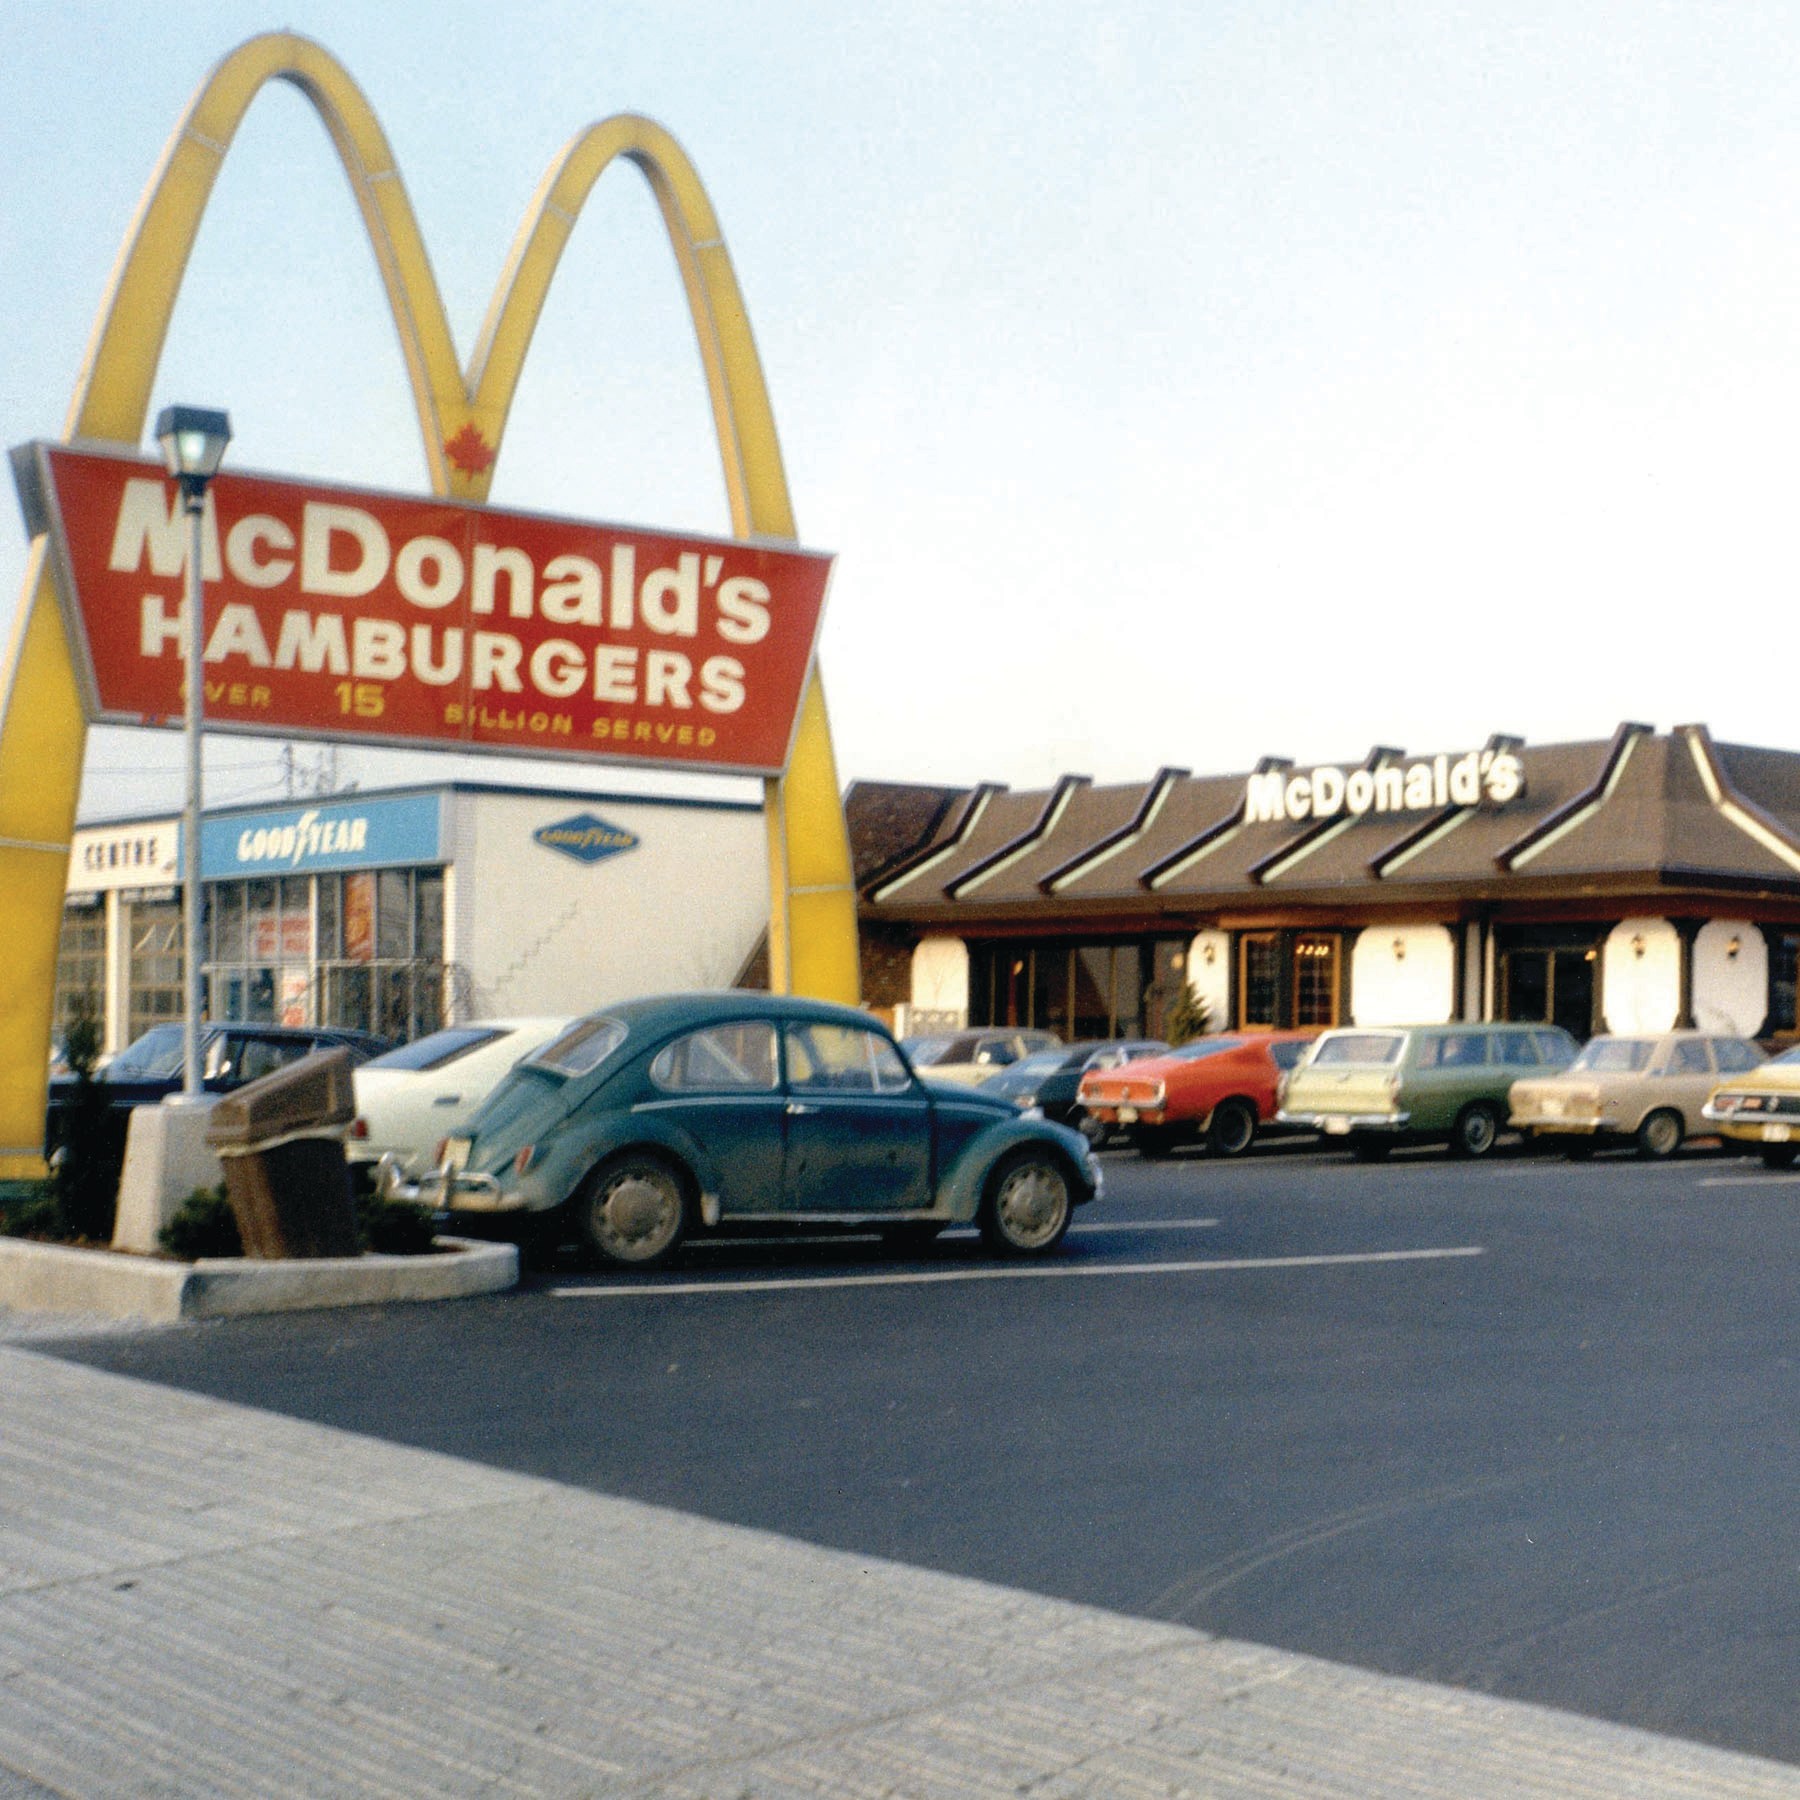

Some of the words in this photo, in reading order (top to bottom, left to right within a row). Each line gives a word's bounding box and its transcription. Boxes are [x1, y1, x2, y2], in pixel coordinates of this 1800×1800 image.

[109, 477, 771, 644] McDonald's
[140, 594, 746, 714] HAMBURGERS
[179, 681, 271, 708] VER
[334, 681, 385, 718] 15
[444, 704, 573, 735] BILLION
[592, 717, 716, 747] SERVED
[1244, 751, 1523, 824] McDonald's
[237, 810, 368, 866] GOODYEAR
